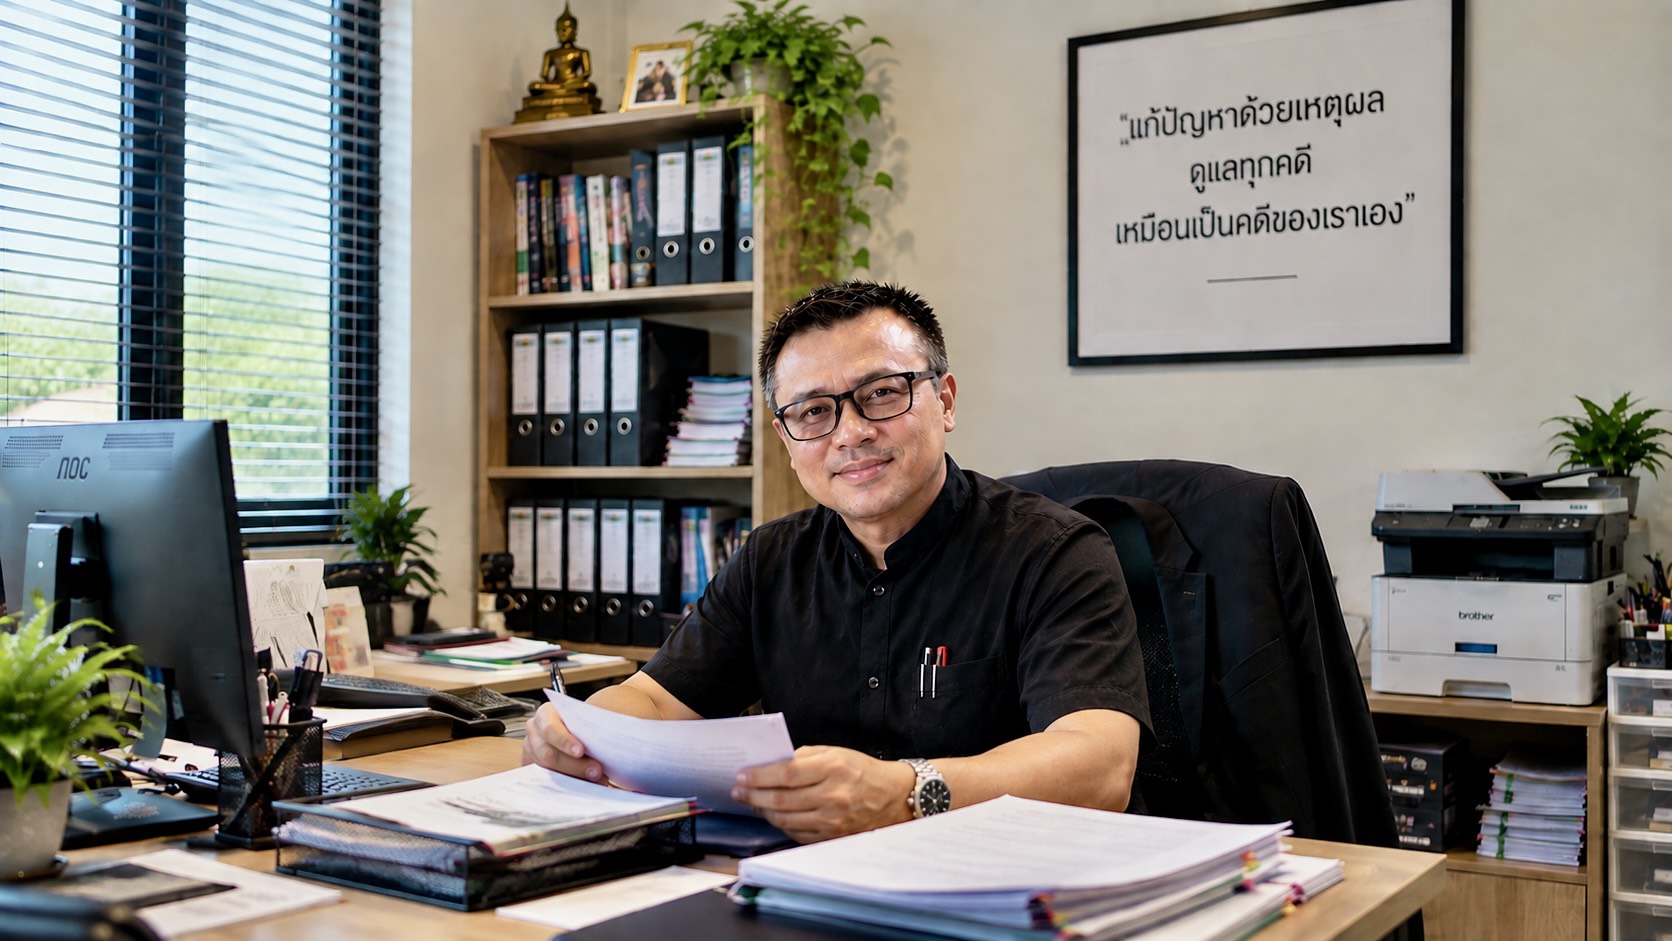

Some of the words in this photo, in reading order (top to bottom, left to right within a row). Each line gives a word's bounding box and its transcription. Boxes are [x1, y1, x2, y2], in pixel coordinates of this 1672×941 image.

[1190, 143, 1312, 194] ดูแลทุกคดี
[1115, 191, 1416, 244] เหมือนเป็นคดีของเราเอง”
[1458, 610, 1495, 621] brother
